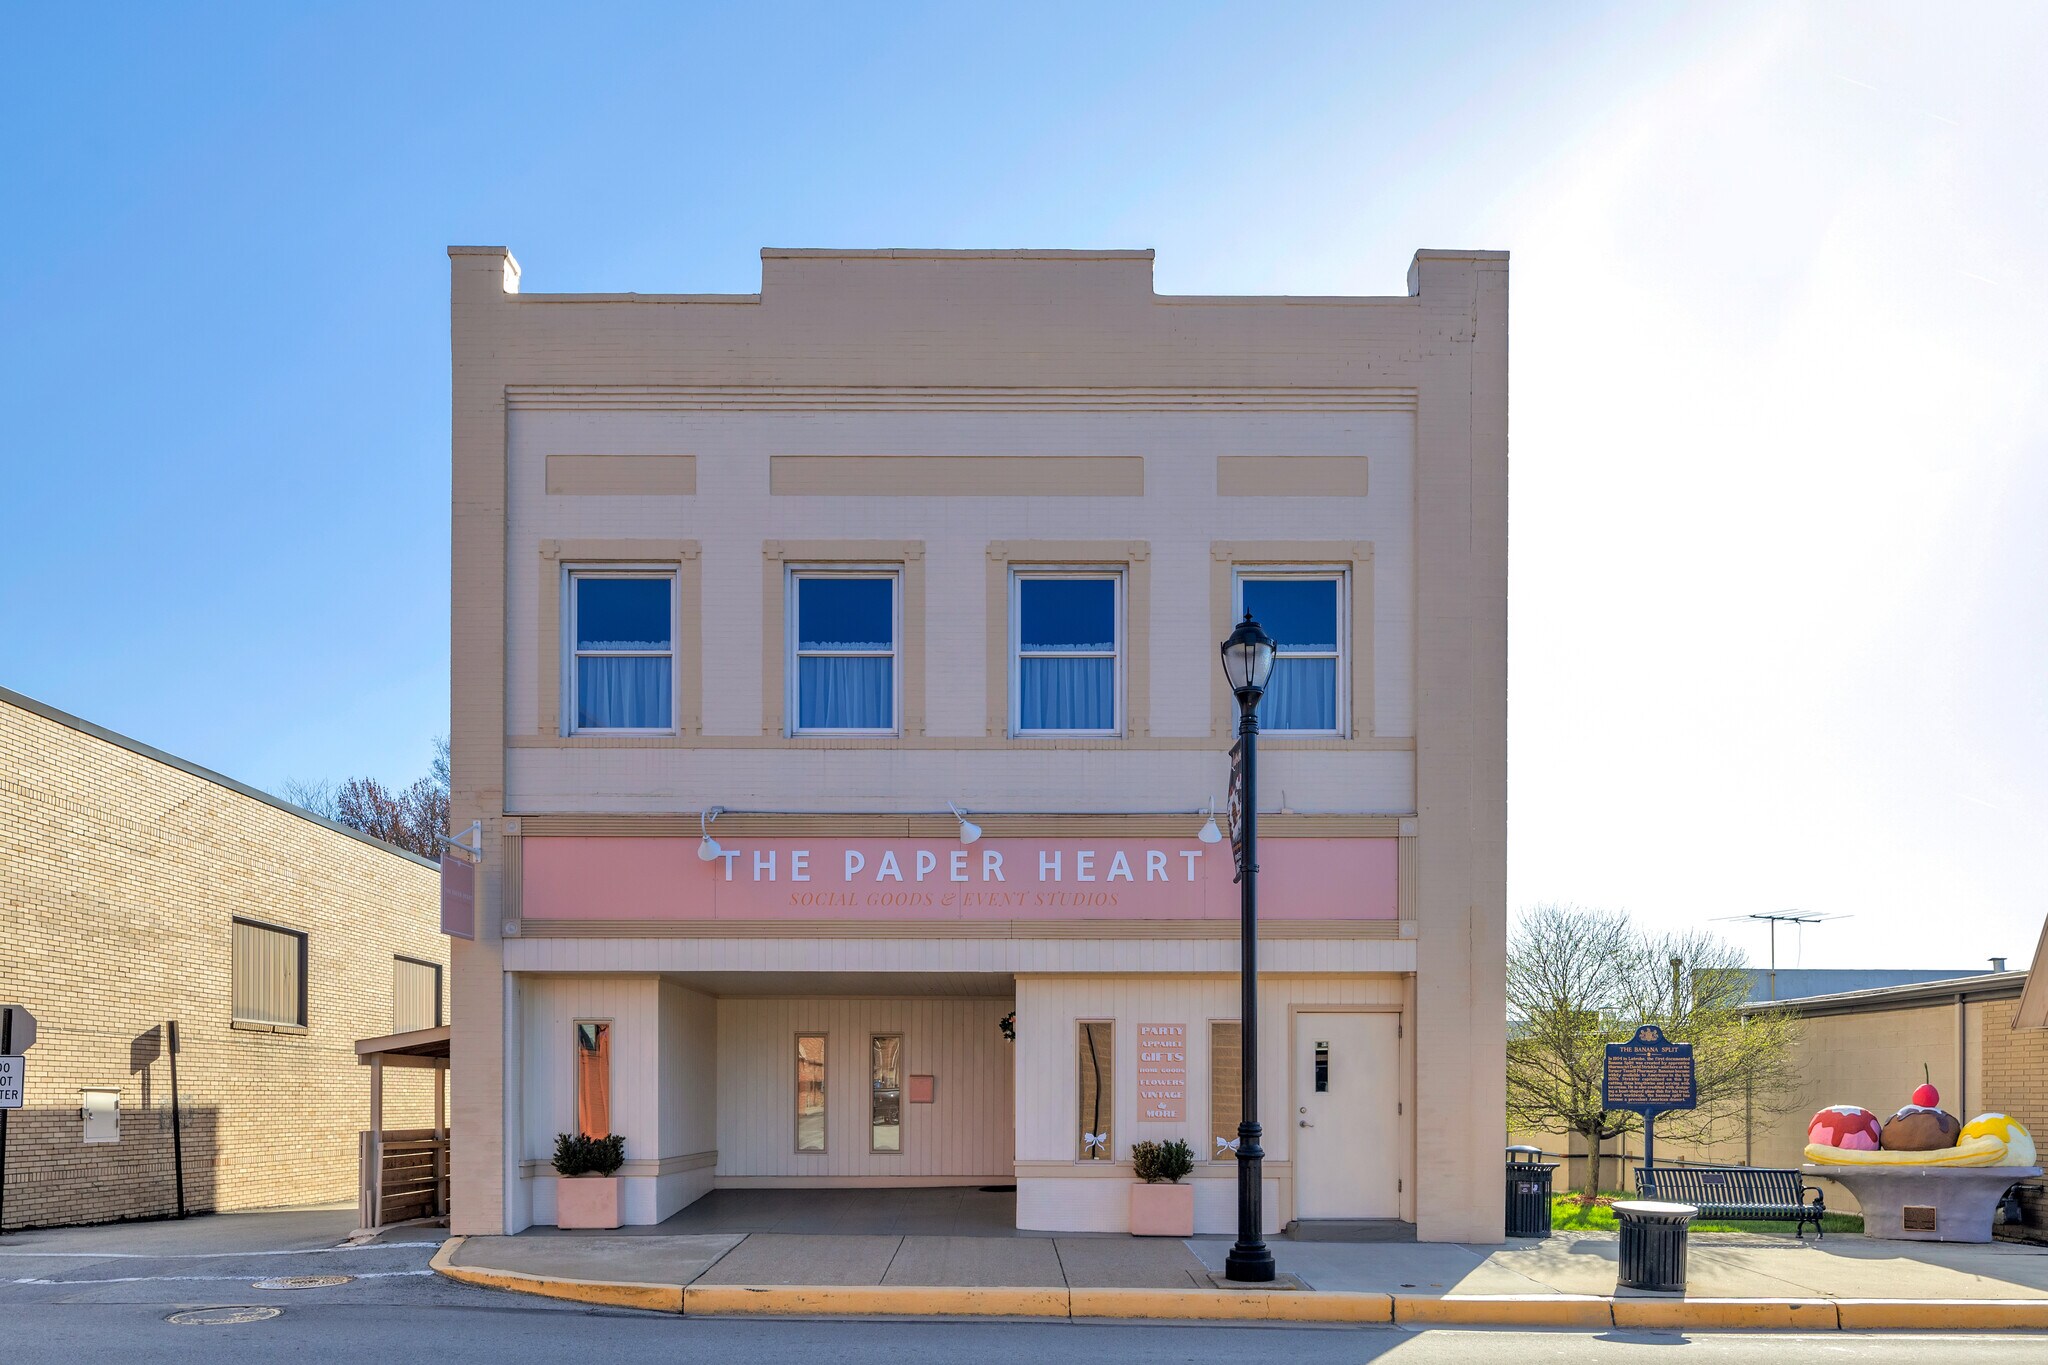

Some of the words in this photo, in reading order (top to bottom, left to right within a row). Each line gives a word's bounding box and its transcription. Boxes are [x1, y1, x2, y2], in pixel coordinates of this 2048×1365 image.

[717, 850, 810, 881] THE
[845, 850, 1006, 881] PAPER
[1039, 850, 1203, 881] HEART
[789, 892, 858, 906] SOCIAL
[866, 892, 933, 906] GOODS
[941, 892, 956, 906] &
[963, 892, 1030, 906] EVENT
[1034, 892, 1119, 906] STUDIOS
[1141, 1026, 1183, 1035] PARTY
[1142, 1040, 1183, 1048] APPAREL
[1141, 1052, 1184, 1062] GIFTS
[0, 1076, 12, 1086] OT
[1141, 1091, 1183, 1099] VINTAGE
[1146, 1110, 1177, 1118] MORE
